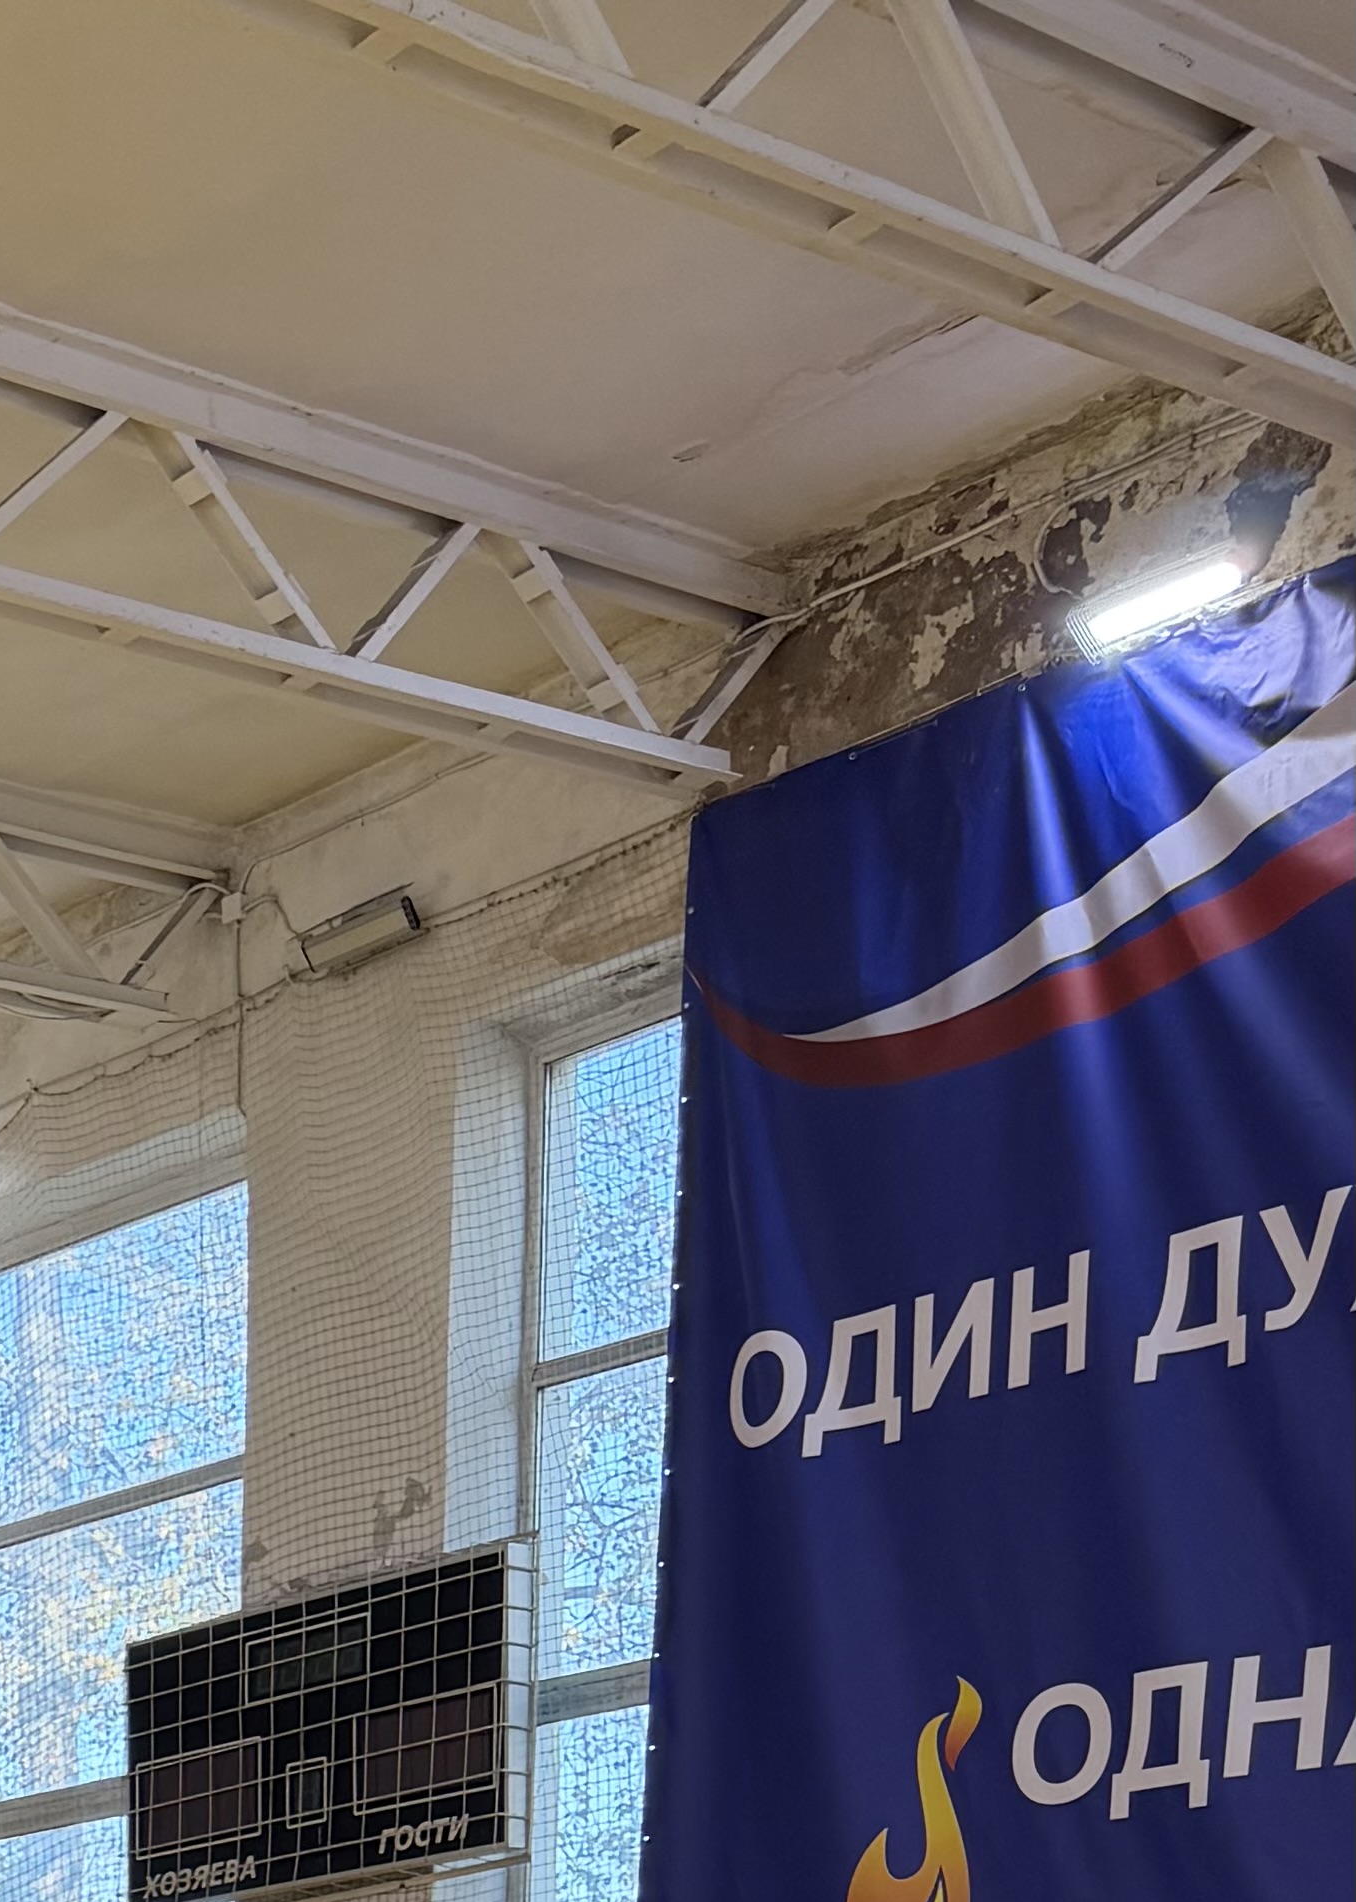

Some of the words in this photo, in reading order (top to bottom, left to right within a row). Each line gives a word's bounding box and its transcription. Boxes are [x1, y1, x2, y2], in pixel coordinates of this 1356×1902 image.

[729, 1250, 1090, 1459] ОДИН
[1134, 1185, 1355, 1383] ДУ
[1011, 1644, 1355, 1820] ОДН
[142, 1855, 256, 1899] ХОЗЯЕВА
[379, 1813, 469, 1854] ГОСТИ
